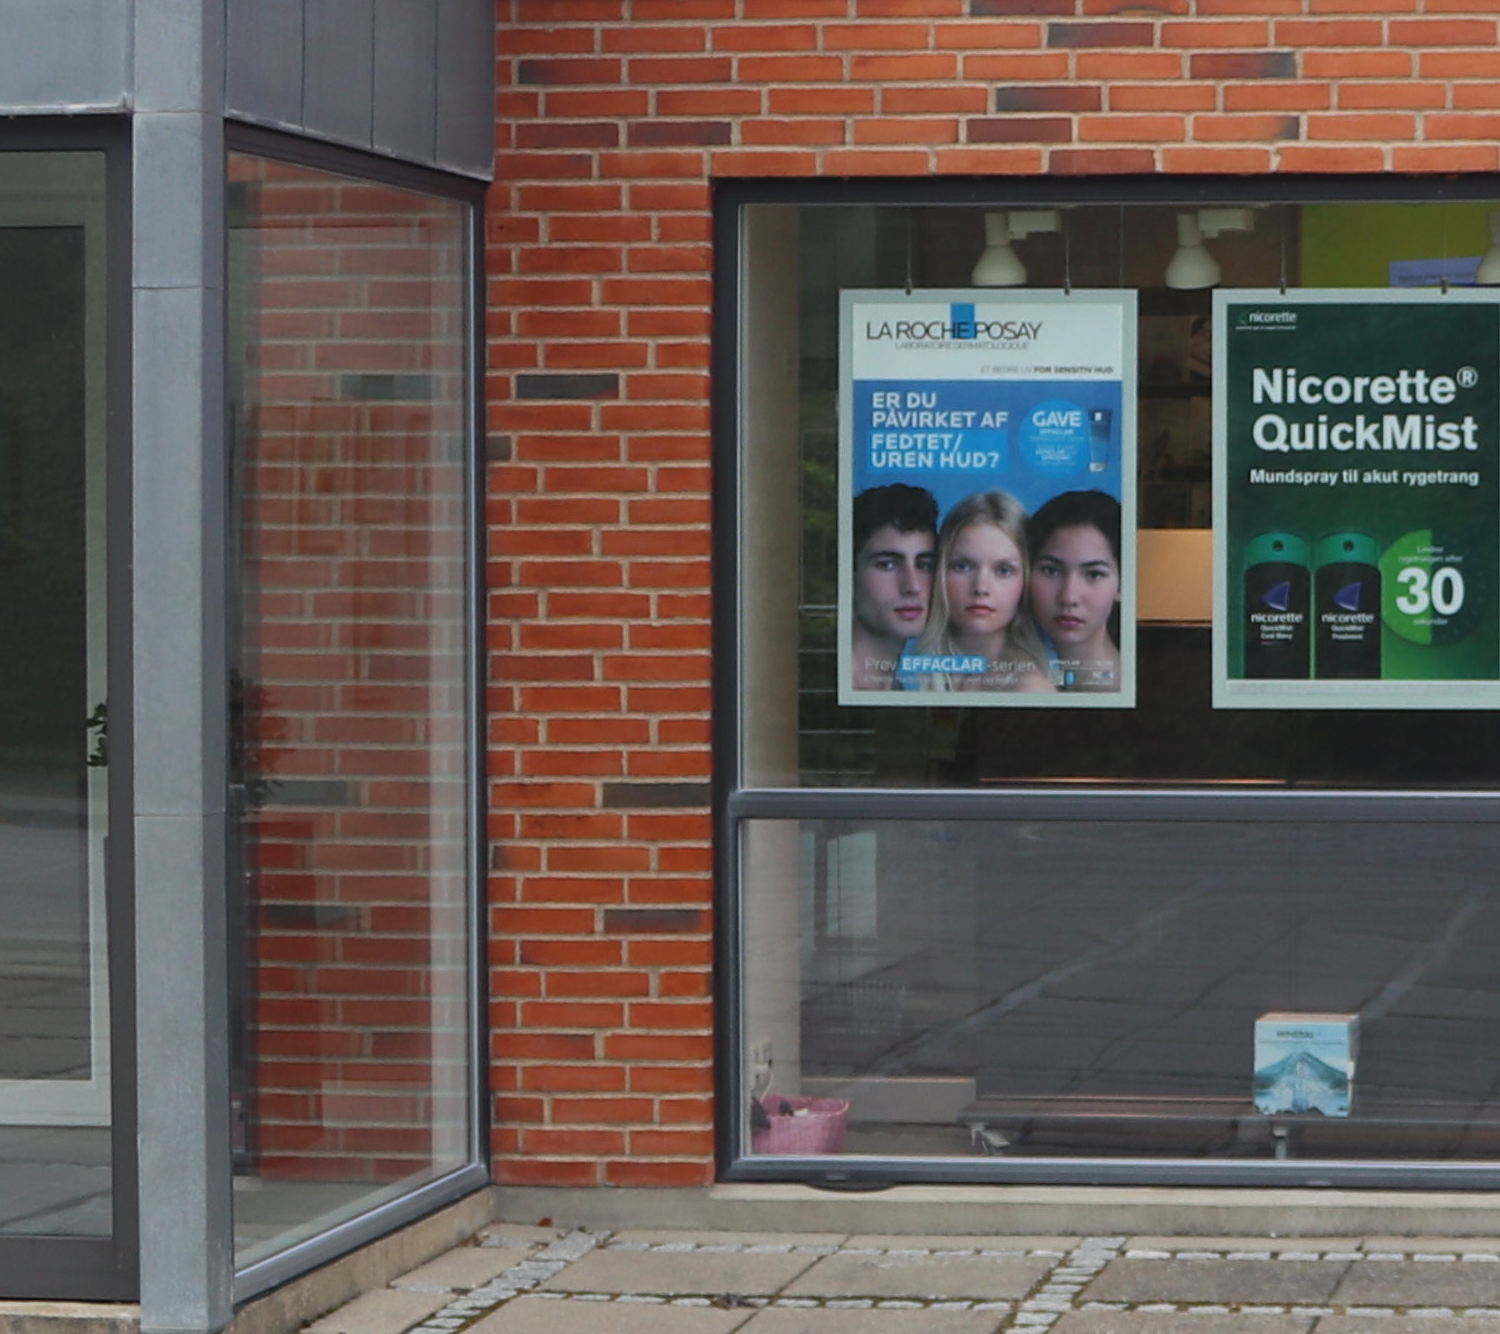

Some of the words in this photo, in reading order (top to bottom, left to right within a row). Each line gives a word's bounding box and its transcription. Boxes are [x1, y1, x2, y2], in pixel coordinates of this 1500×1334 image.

[1249, 311, 1297, 323] nicorette
[866, 321, 892, 340] LA
[974, 321, 1042, 340] POSAY
[1252, 365, 1479, 404] Nicorette®
[871, 391, 900, 409] ER
[906, 391, 937, 409] DU
[871, 407, 976, 428] PÅVIRKET
[980, 411, 1009, 428] AF
[1031, 410, 1082, 427] GAVE
[1252, 413, 1479, 453] QuickMist
[871, 433, 963, 452] FEDTET/
[871, 451, 933, 468] UREN
[940, 451, 1000, 468] HUD?
[1250, 469, 1339, 486] Mundspray
[1342, 469, 1358, 483] til
[1362, 469, 1398, 483] akut
[1402, 470, 1480, 486] rygetrang
[1395, 566, 1465, 615] 30
[1251, 612, 1304, 623] nicorette
[1321, 612, 1375, 623] nicorette
[865, 657, 897, 671] Prøv
[902, 657, 983, 672] EFFACLAR
